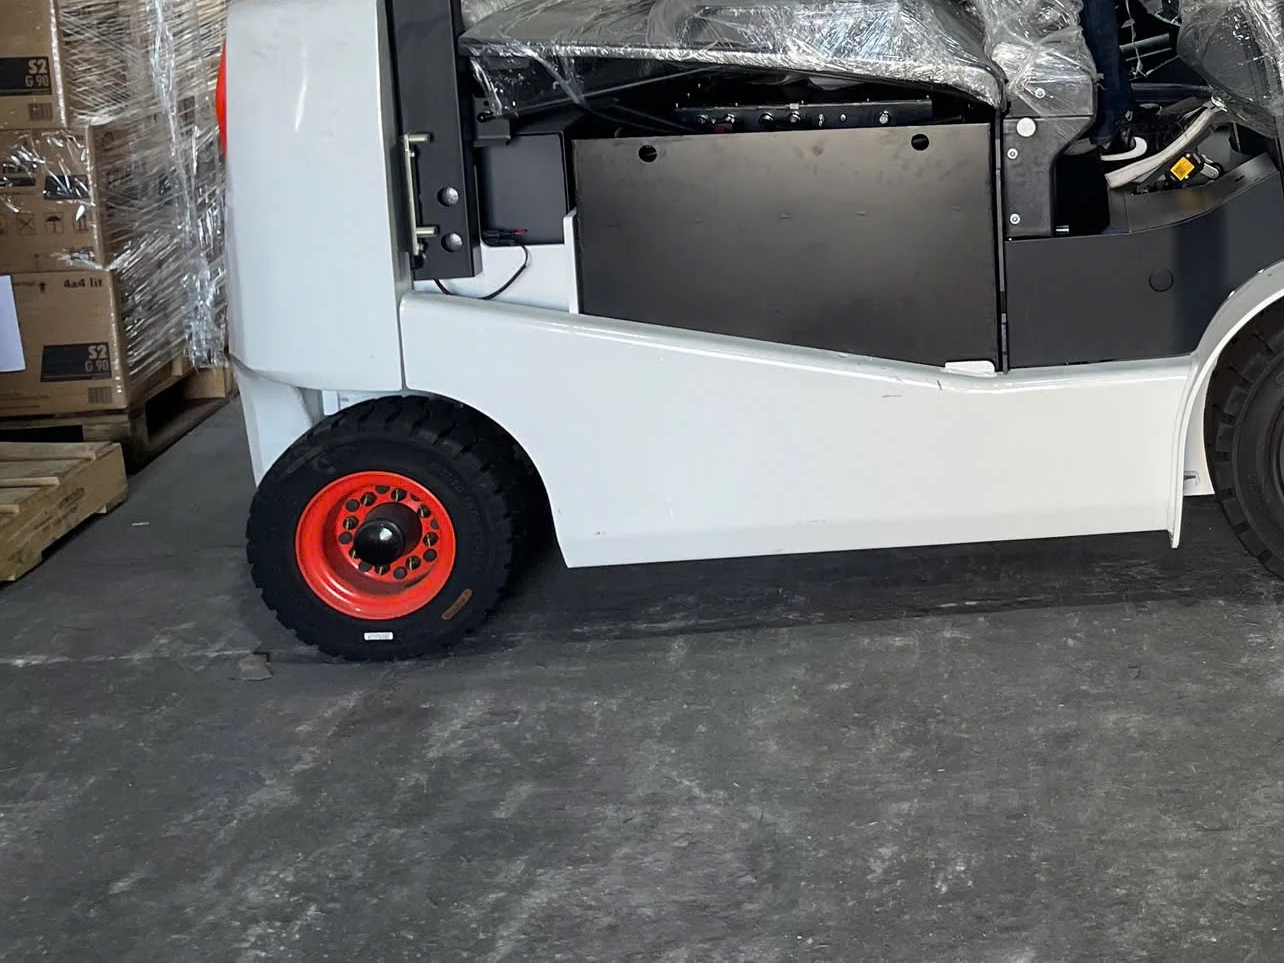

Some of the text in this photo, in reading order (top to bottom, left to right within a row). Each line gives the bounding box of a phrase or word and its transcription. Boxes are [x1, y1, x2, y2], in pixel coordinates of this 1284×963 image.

[28, 59, 48, 75] S2
[24, 74, 49, 88] G 90
[63, 277, 103, 288] 4x4 lit
[87, 344, 108, 360] S2
[84, 359, 109, 373] G 90
